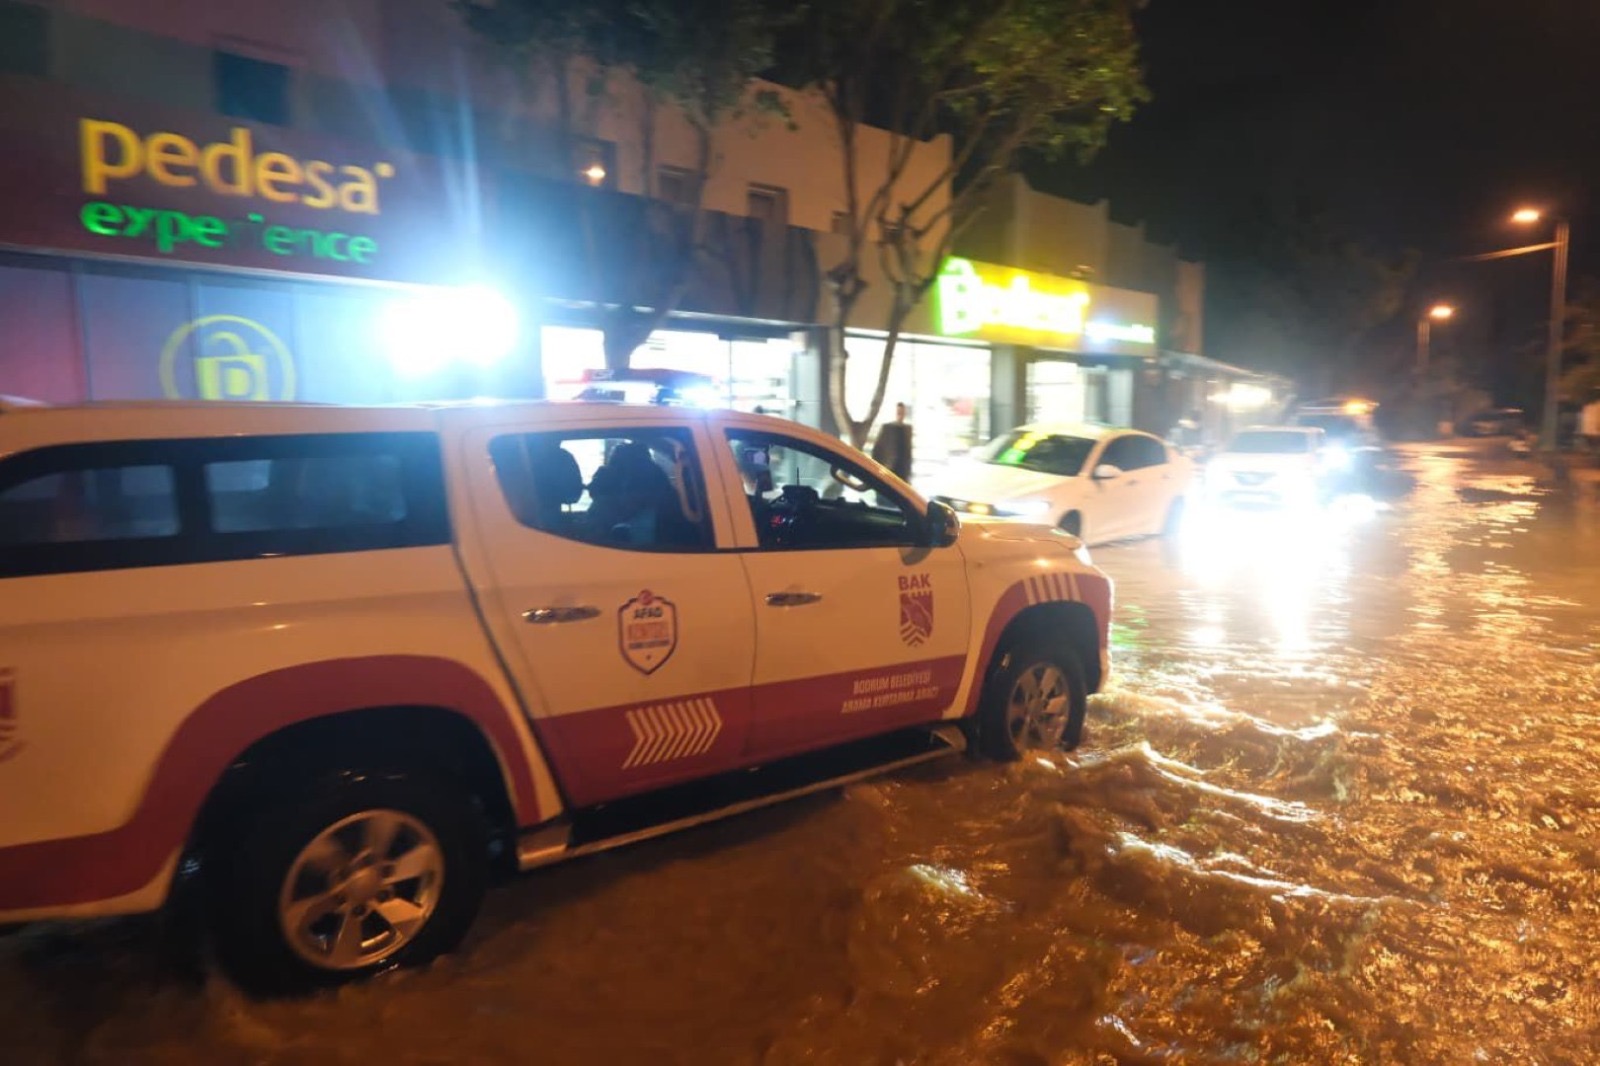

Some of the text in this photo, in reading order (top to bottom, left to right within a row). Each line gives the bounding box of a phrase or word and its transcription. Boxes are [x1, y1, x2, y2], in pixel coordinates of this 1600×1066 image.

[80, 118, 381, 215] pedesa
[80, 201, 378, 263] expeence
[898, 573, 931, 591] BAK
[853, 677, 889, 695] BODRUM
